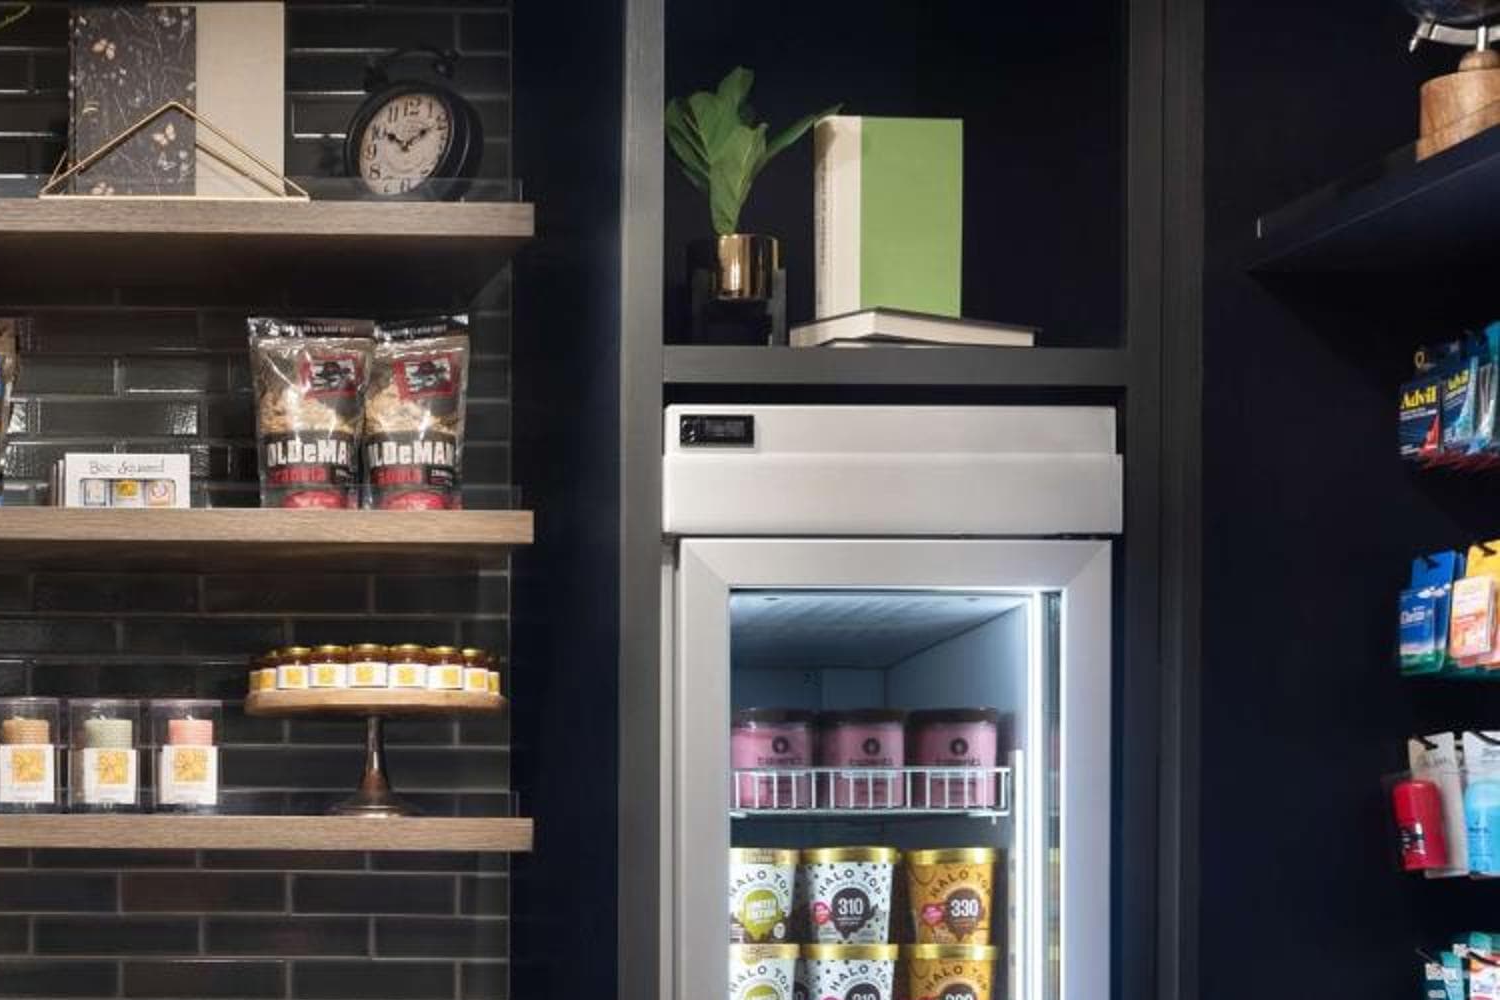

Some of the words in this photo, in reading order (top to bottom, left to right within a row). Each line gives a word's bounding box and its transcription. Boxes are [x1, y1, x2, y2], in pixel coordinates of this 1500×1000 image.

[818, 867, 856, 898] HALO
[862, 870, 884, 897] TOP
[930, 868, 970, 898] HALO
[837, 897, 864, 916] 310
[950, 898, 979, 918] 330
[829, 963, 870, 991] HALO
[925, 964, 965, 990] HALO
